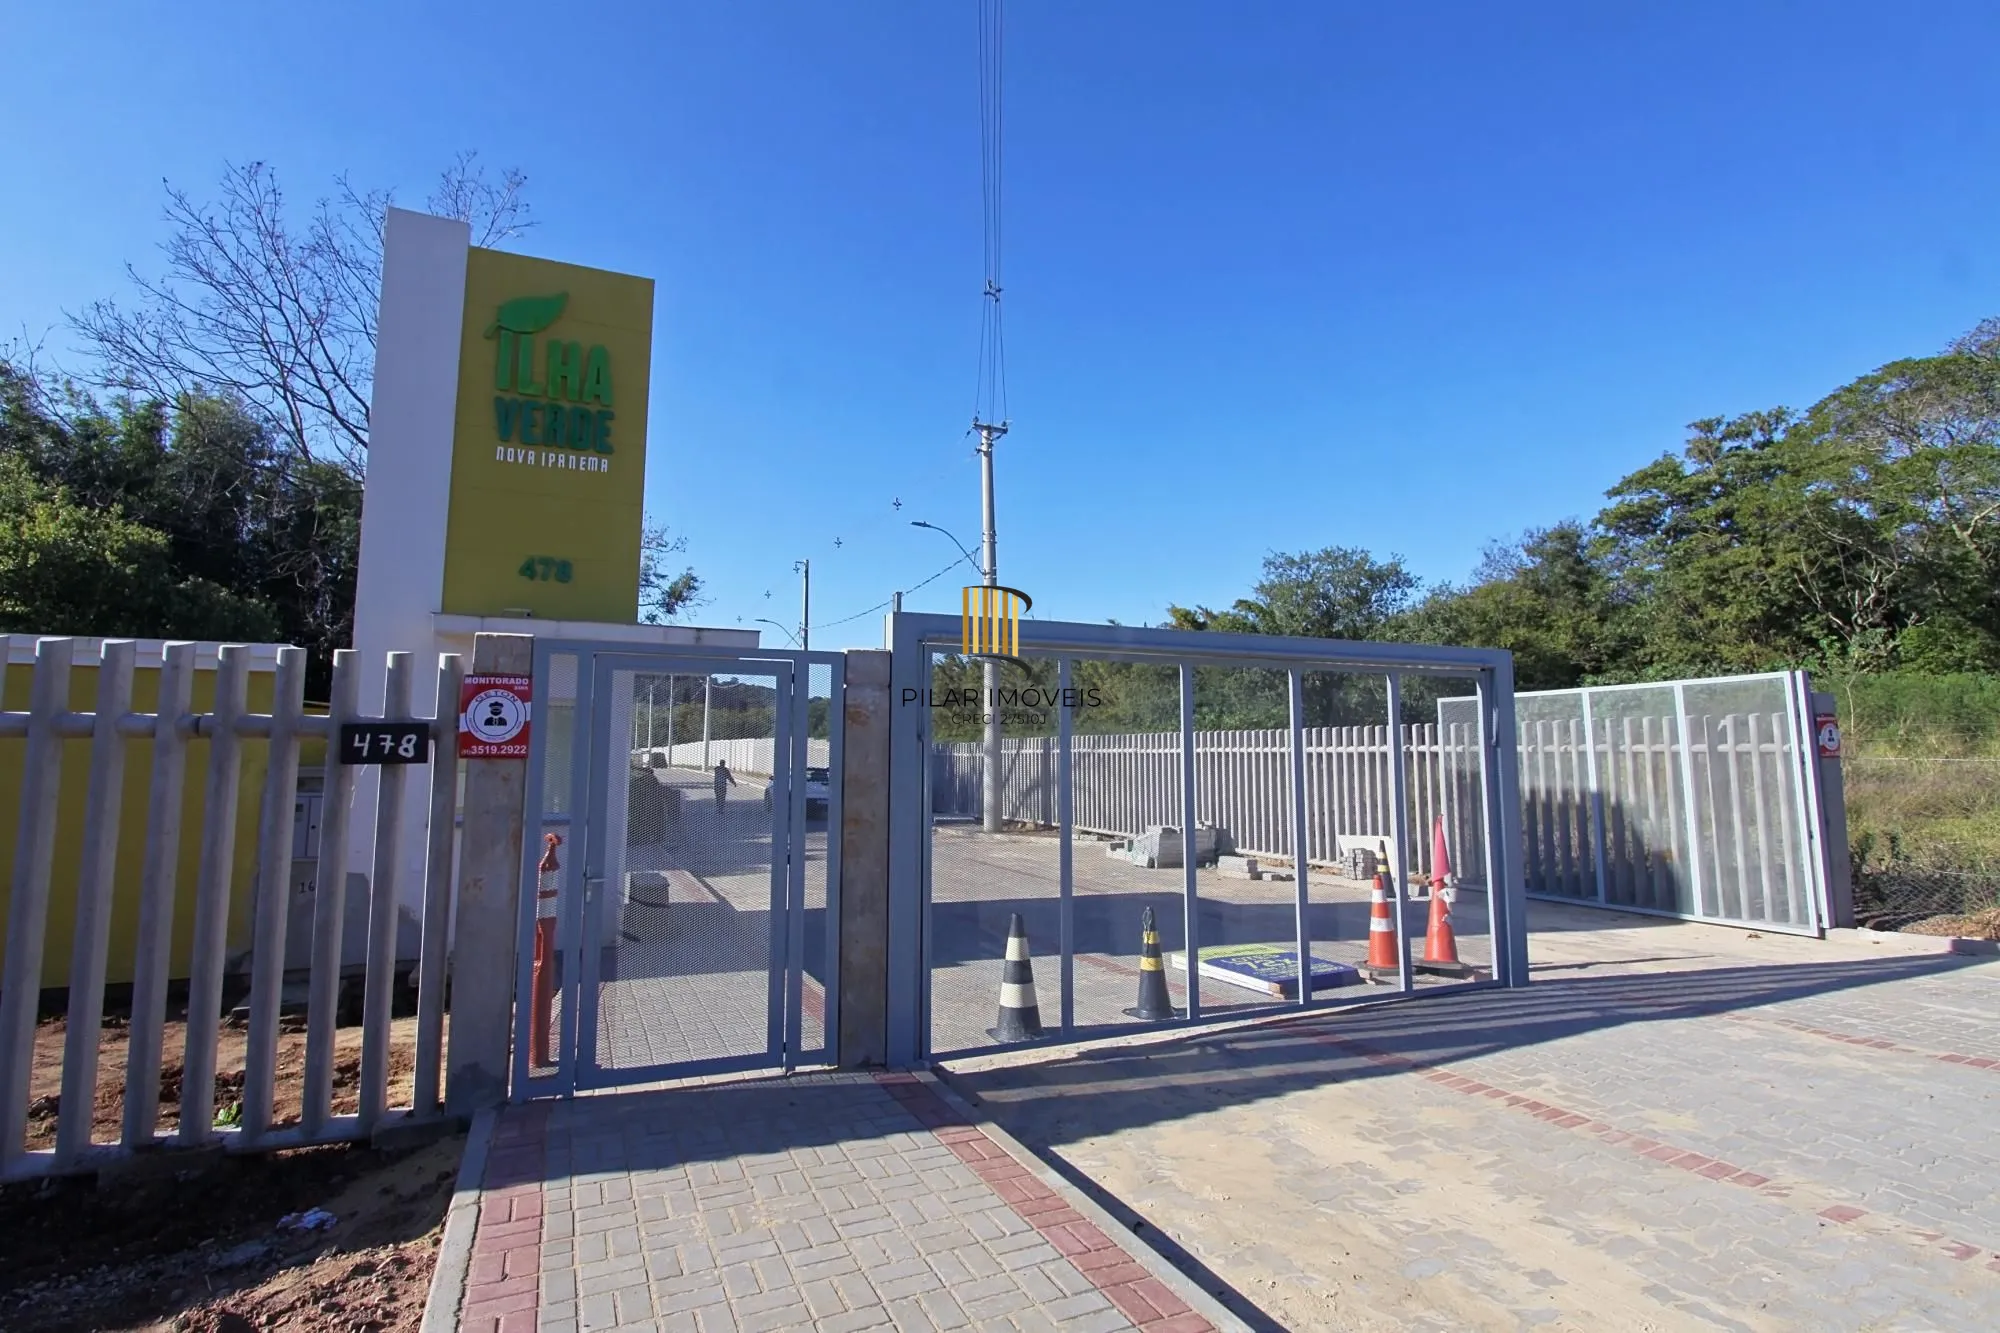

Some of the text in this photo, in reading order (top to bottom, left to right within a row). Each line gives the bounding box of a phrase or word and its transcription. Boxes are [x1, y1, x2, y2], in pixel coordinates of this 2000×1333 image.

[494, 331, 614, 408] ILHA
[493, 396, 615, 455] VERDE
[496, 446, 609, 473] NOVA IPANEMA
[518, 556, 573, 584] 478
[464, 676, 529, 685] MONITORADO
[353, 732, 418, 758] 478
